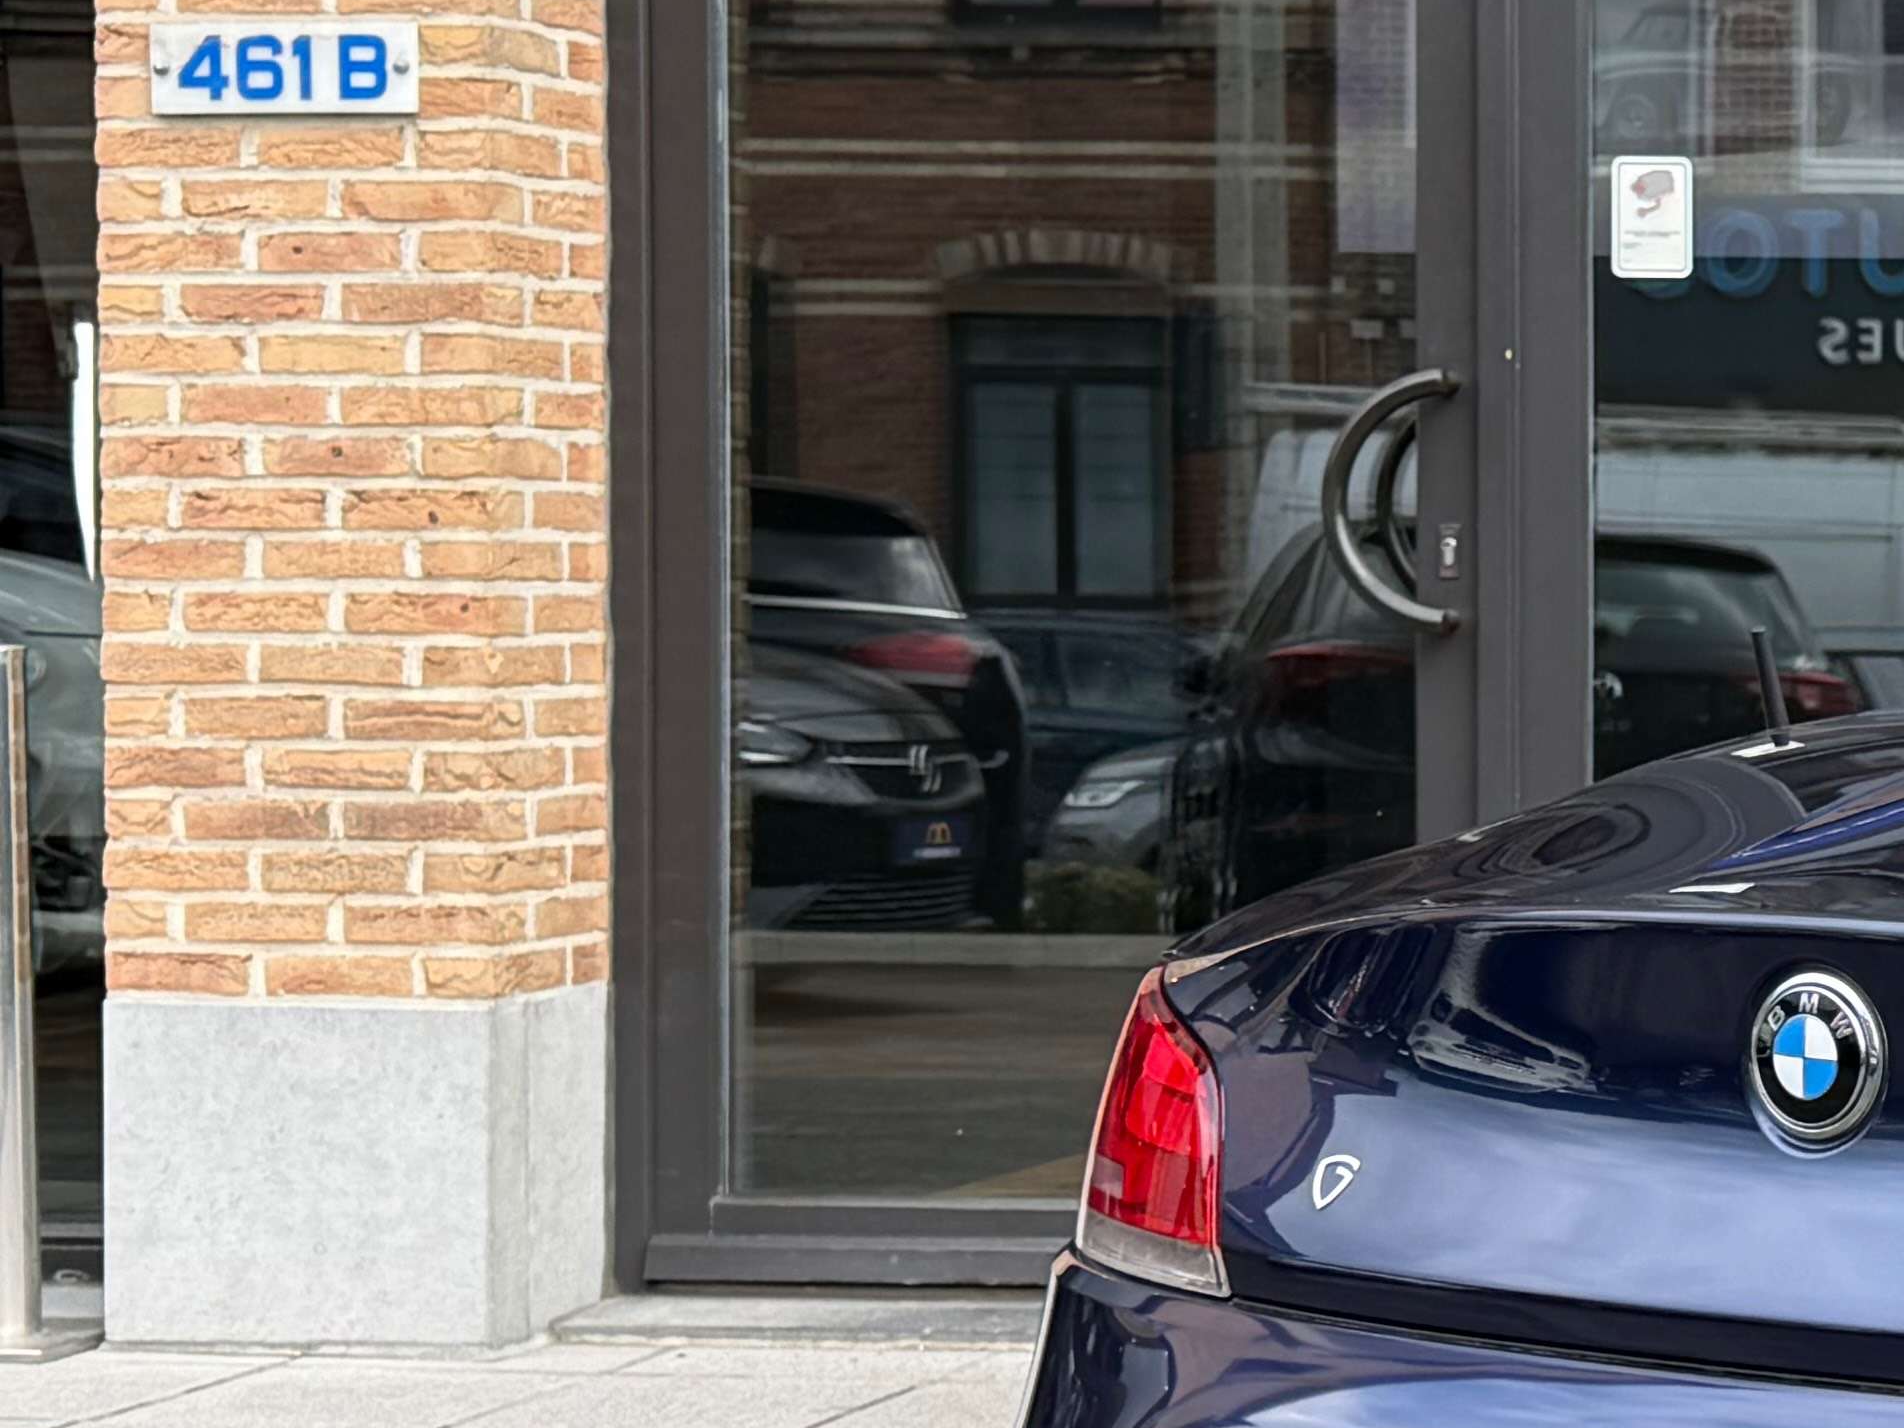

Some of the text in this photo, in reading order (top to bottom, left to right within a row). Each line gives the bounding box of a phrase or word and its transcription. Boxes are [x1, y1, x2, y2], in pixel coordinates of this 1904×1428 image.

[178, 35, 387, 100] 461 B
[1767, 991, 1853, 1040] BMW
